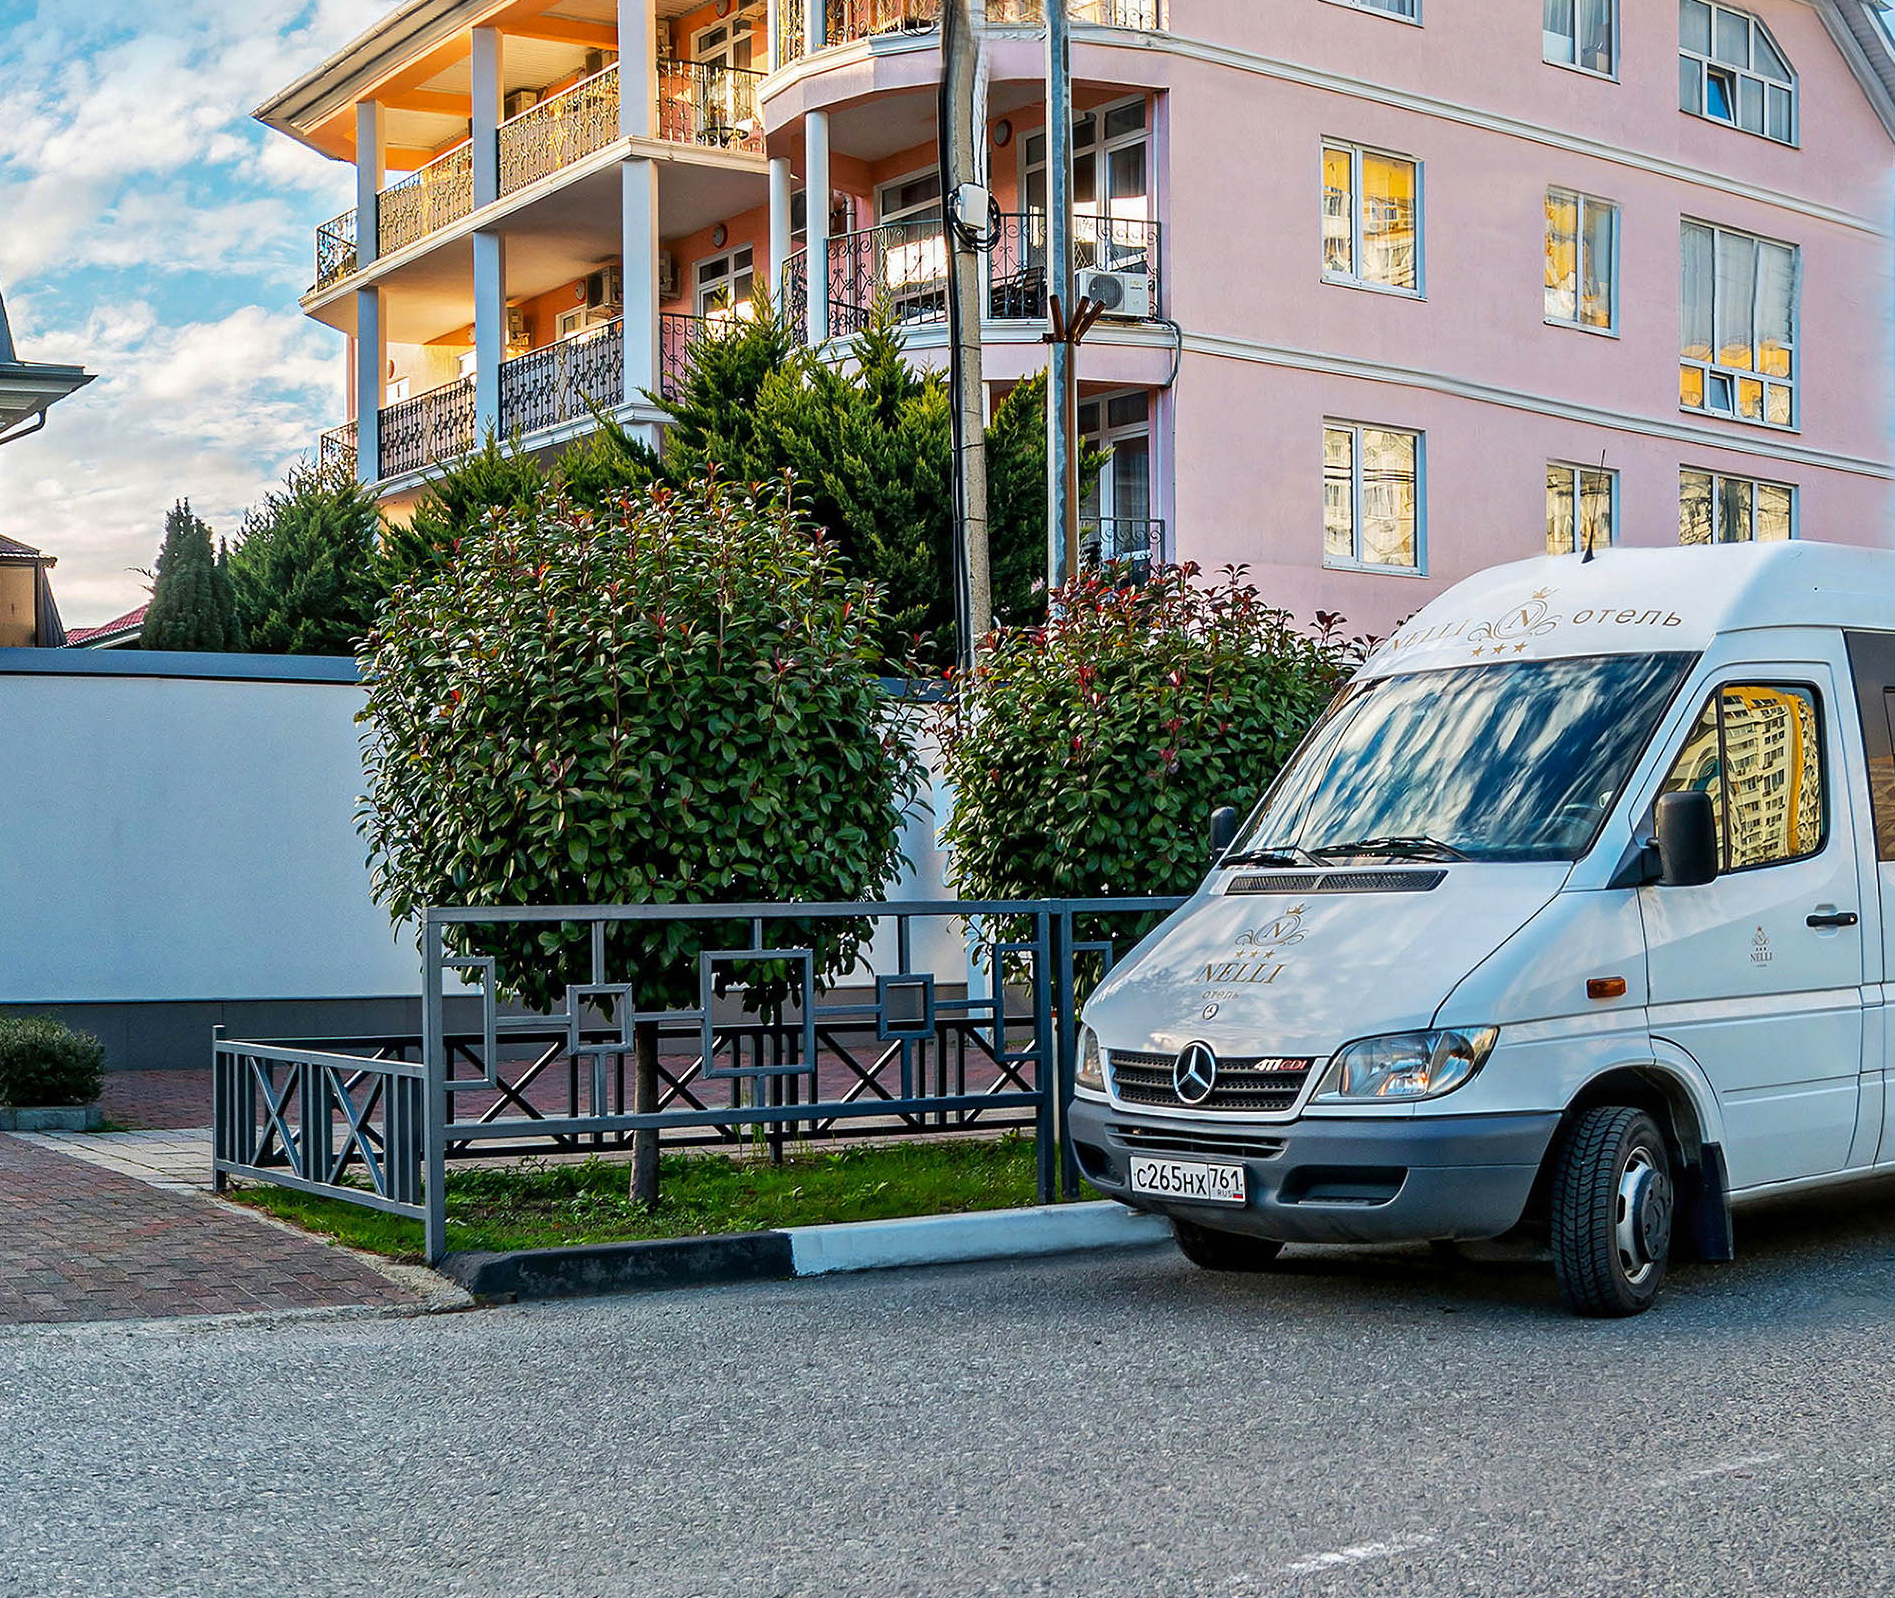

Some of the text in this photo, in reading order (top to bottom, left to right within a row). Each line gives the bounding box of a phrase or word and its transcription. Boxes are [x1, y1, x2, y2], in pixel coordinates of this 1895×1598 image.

[1571, 608, 1684, 627] отель
[1195, 962, 1287, 984] NELLI
[1209, 1168, 1240, 1190] 761
